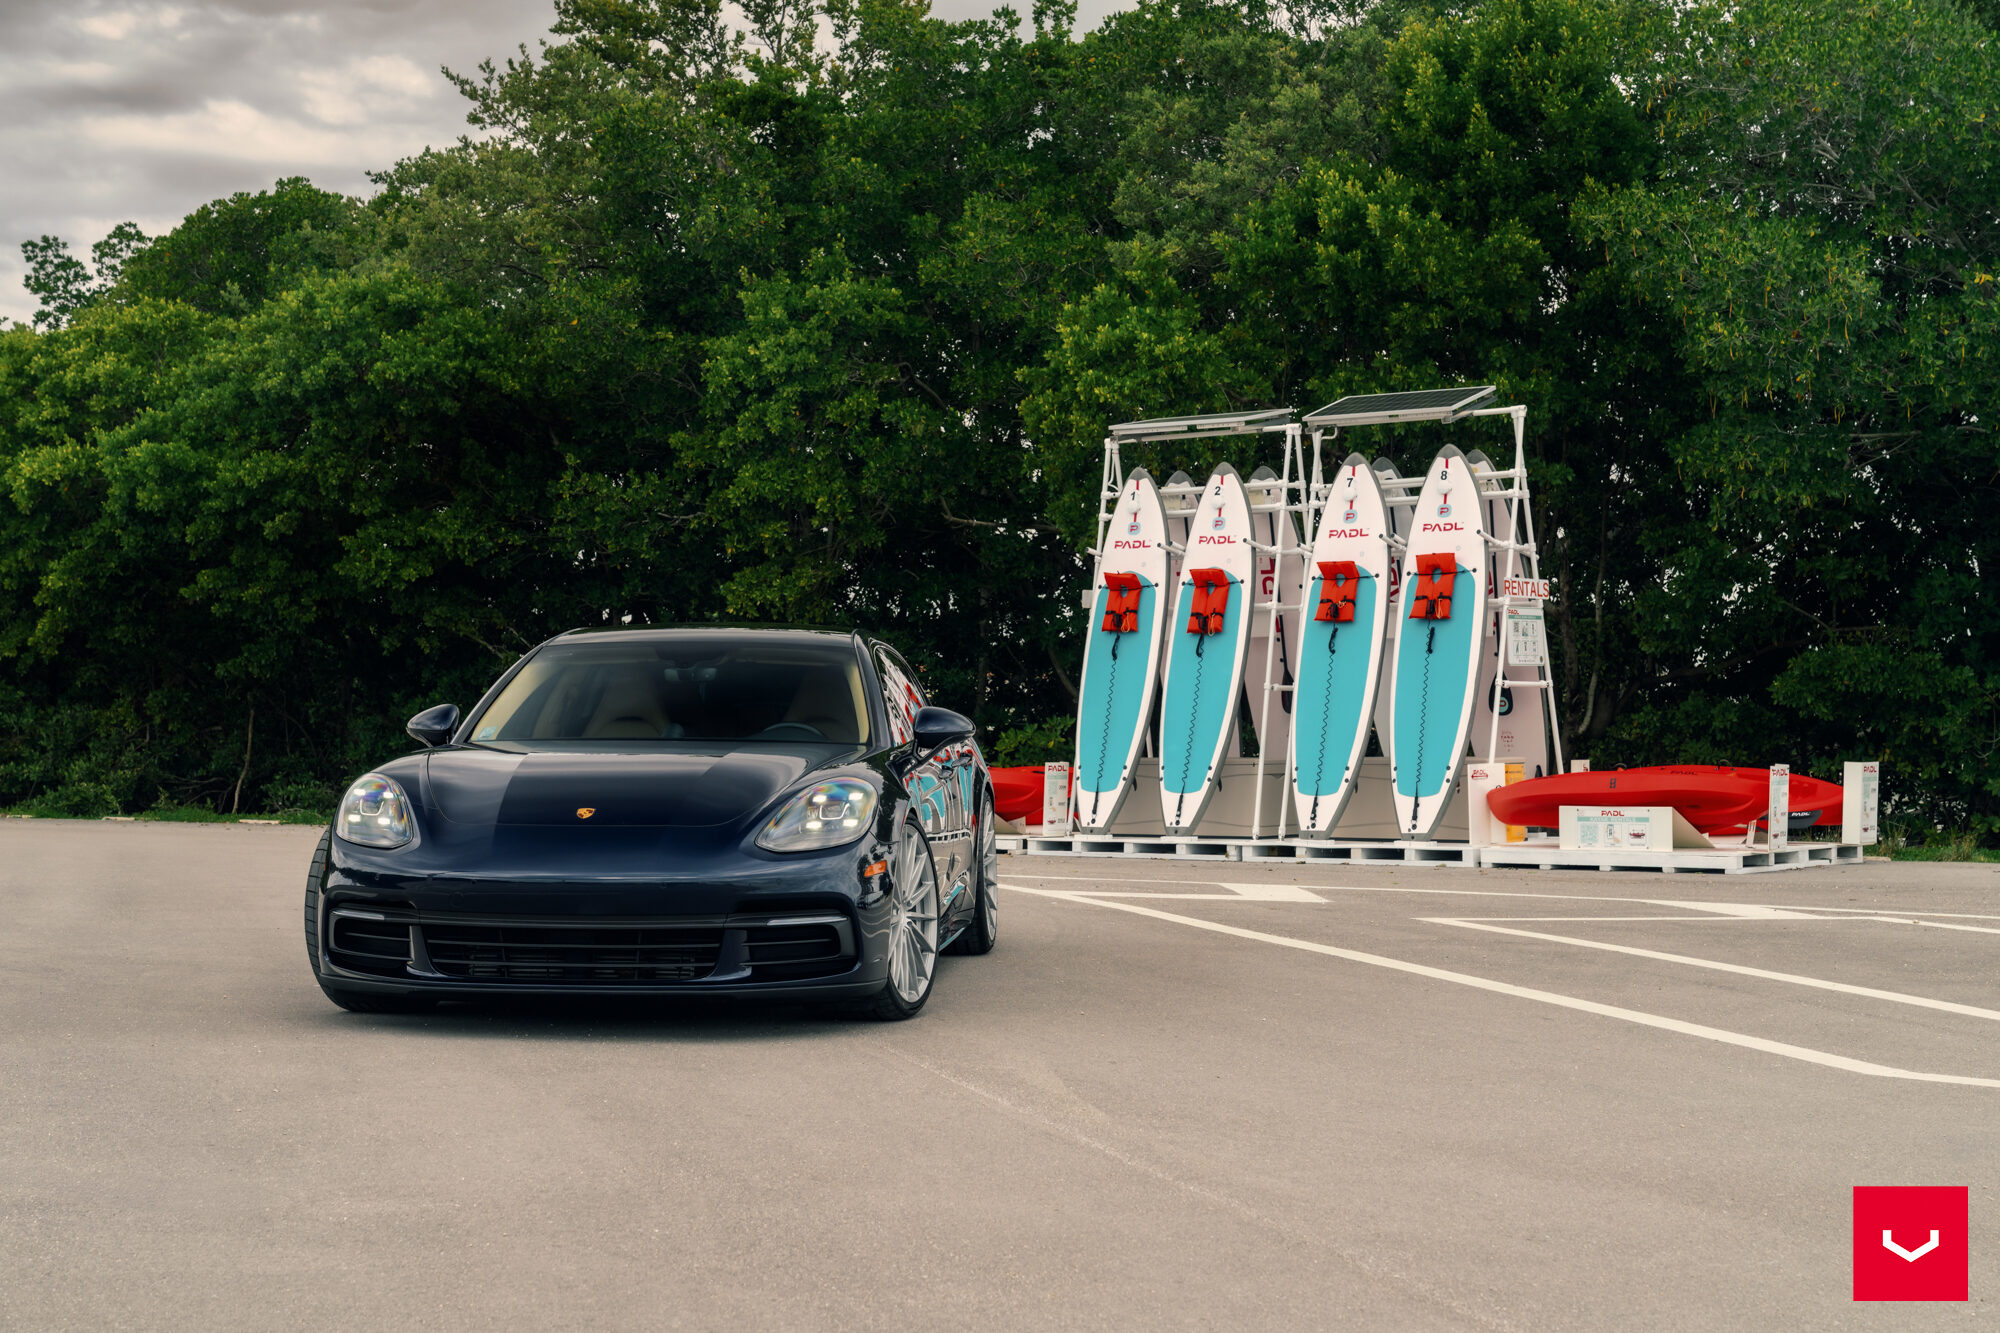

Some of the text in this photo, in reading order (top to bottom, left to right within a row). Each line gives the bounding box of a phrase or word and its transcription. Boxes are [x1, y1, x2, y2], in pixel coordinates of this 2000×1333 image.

[1441, 470, 1447, 480] 8
[1346, 478, 1353, 487] 7
[1130, 491, 1136, 500] 1
[1214, 486, 1221, 496] 2
[1423, 522, 1464, 532] PADL
[1328, 528, 1369, 539] PADL
[1114, 540, 1151, 549] PADL
[1198, 535, 1237, 545] PADL
[1504, 579, 1549, 598] RENTALS
[1772, 768, 1788, 777] PADL
[1863, 765, 1877, 773] PADL
